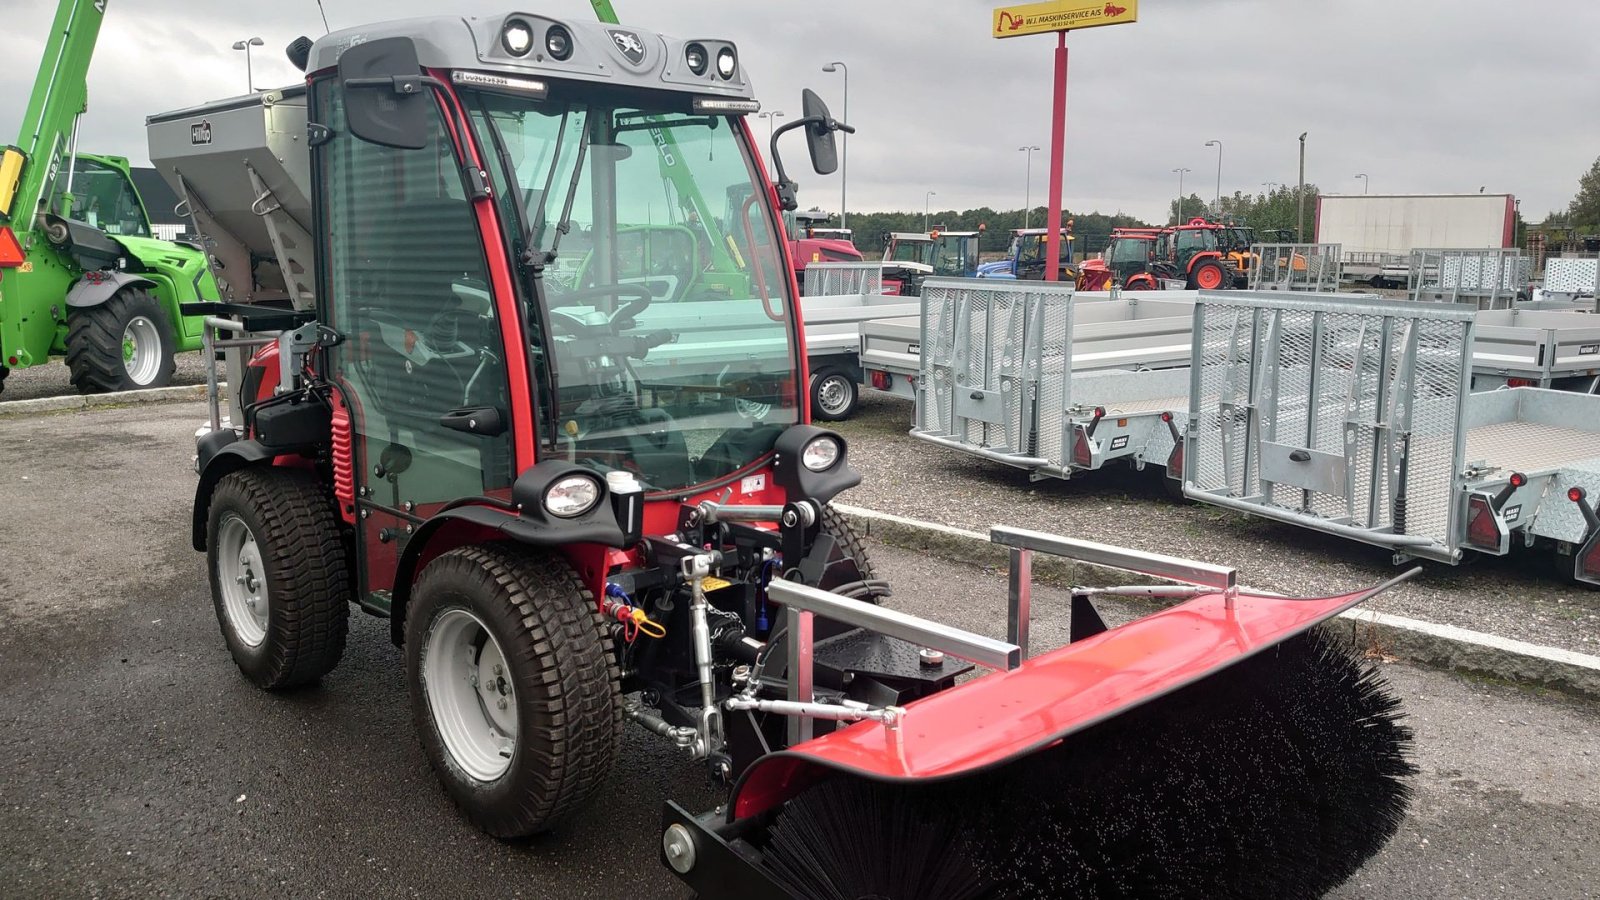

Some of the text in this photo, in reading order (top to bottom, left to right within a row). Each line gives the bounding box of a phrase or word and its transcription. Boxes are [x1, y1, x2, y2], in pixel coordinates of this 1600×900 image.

[1038, 11, 1089, 24] MASKINSERVICE
[1090, 8, 1102, 17] A/S
[1505, 507, 1519, 516] MAXI
